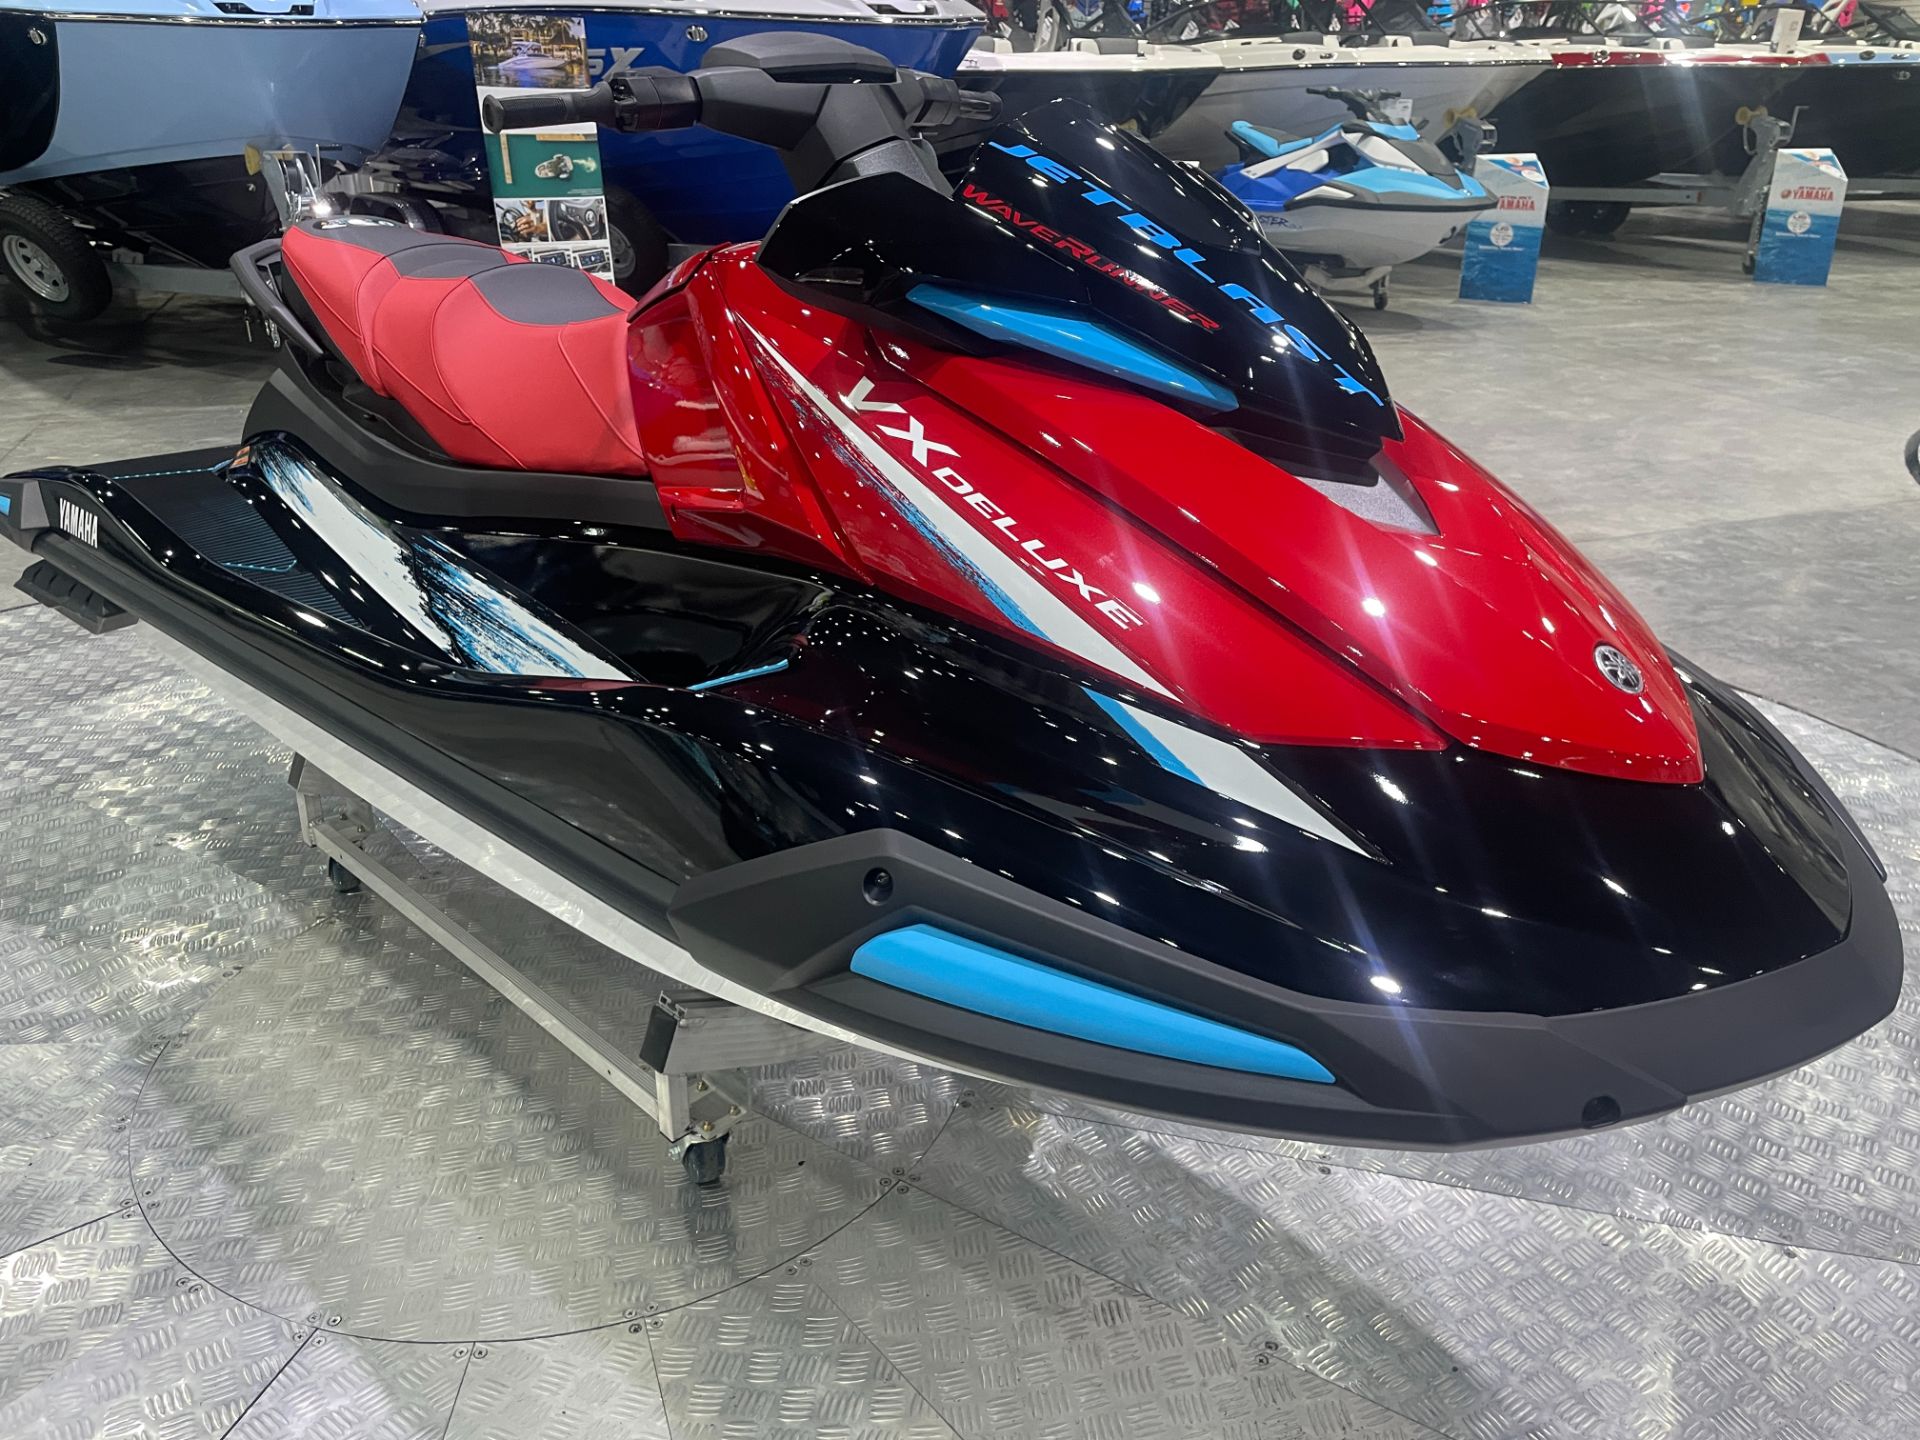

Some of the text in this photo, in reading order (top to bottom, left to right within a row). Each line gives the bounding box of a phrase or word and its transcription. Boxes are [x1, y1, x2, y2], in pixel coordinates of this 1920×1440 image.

[1498, 199, 1536, 211] AMAHA
[1792, 190, 1834, 201] YAMAHA
[988, 141, 1384, 407] JETBLAST
[59, 497, 98, 549] YAMAHA
[838, 376, 1144, 631] VX DELUXE
